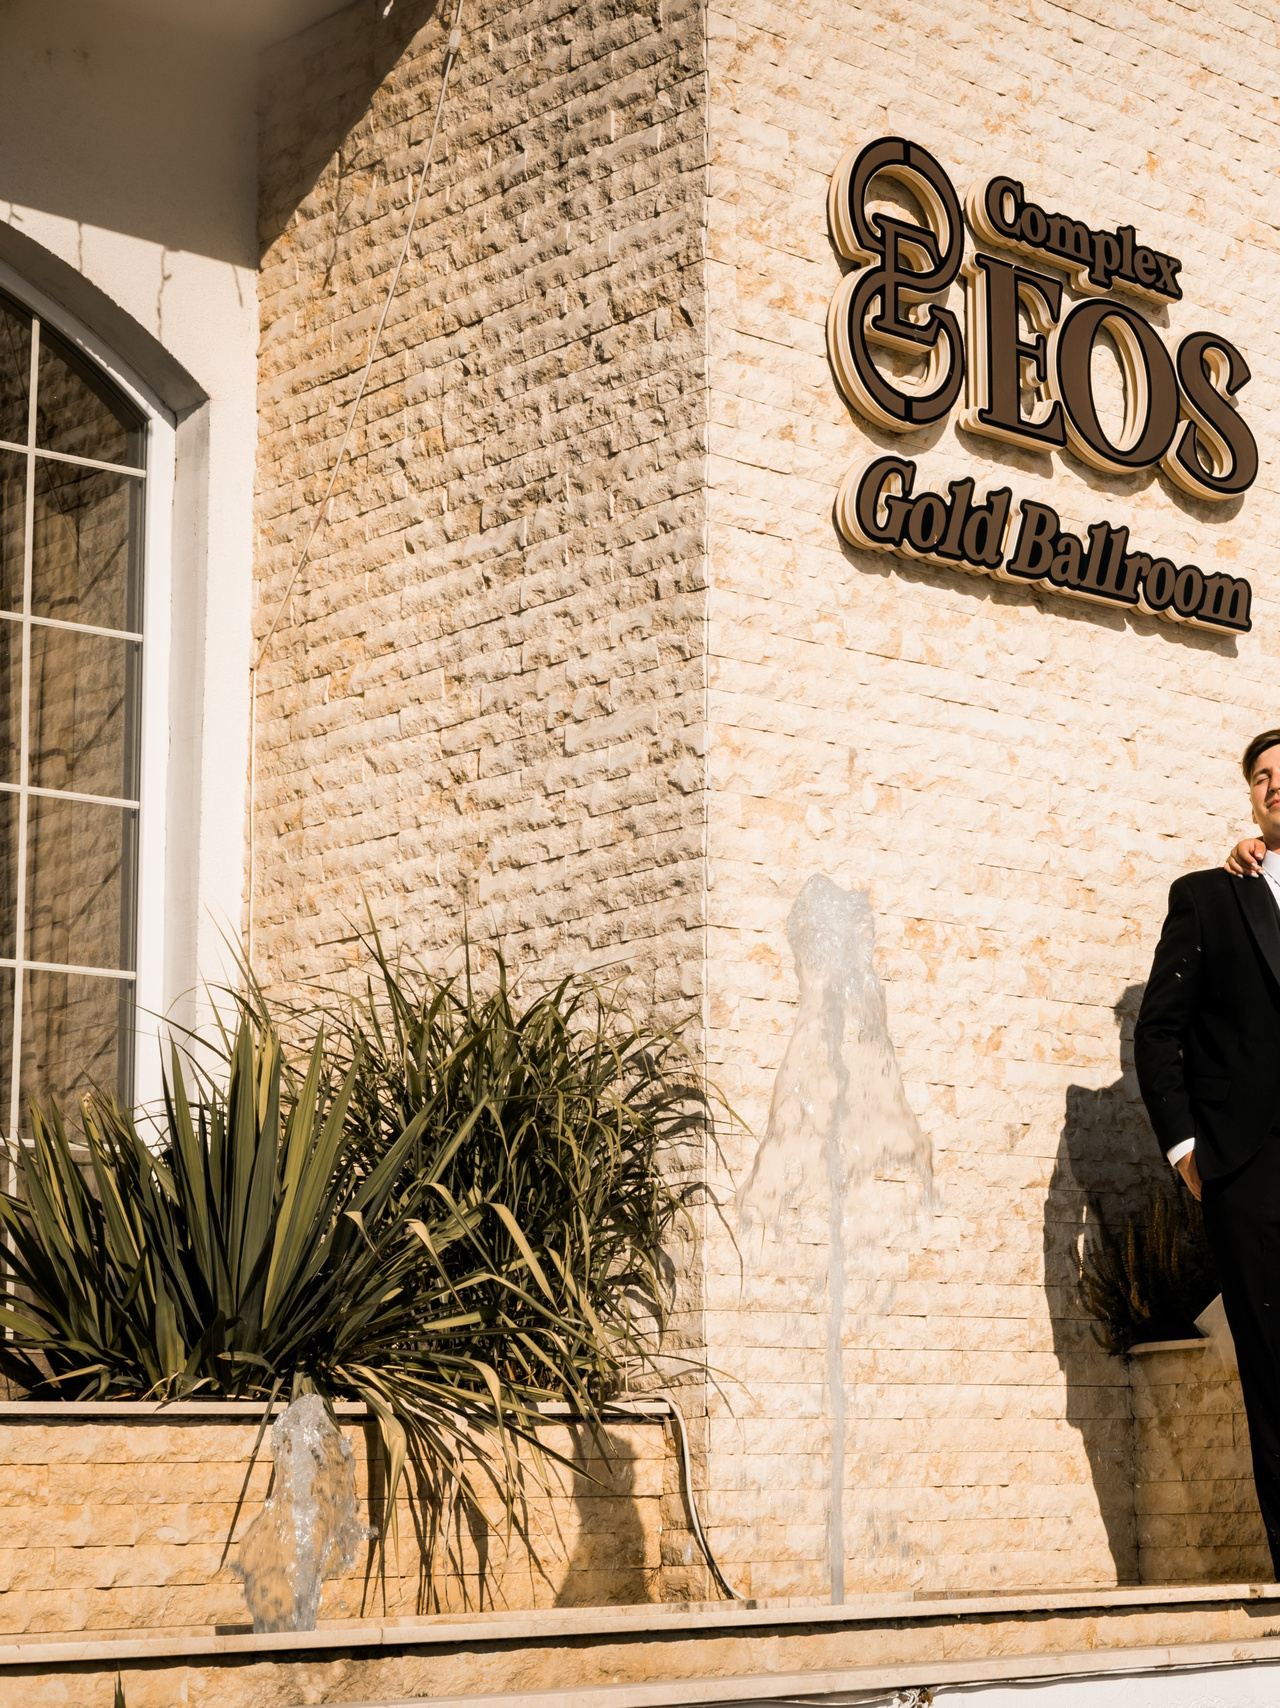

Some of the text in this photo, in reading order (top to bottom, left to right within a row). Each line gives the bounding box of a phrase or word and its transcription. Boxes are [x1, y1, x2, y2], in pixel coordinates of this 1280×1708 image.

[983, 175, 1184, 301] Complex
[855, 455, 1253, 633] Gold Ballroom
